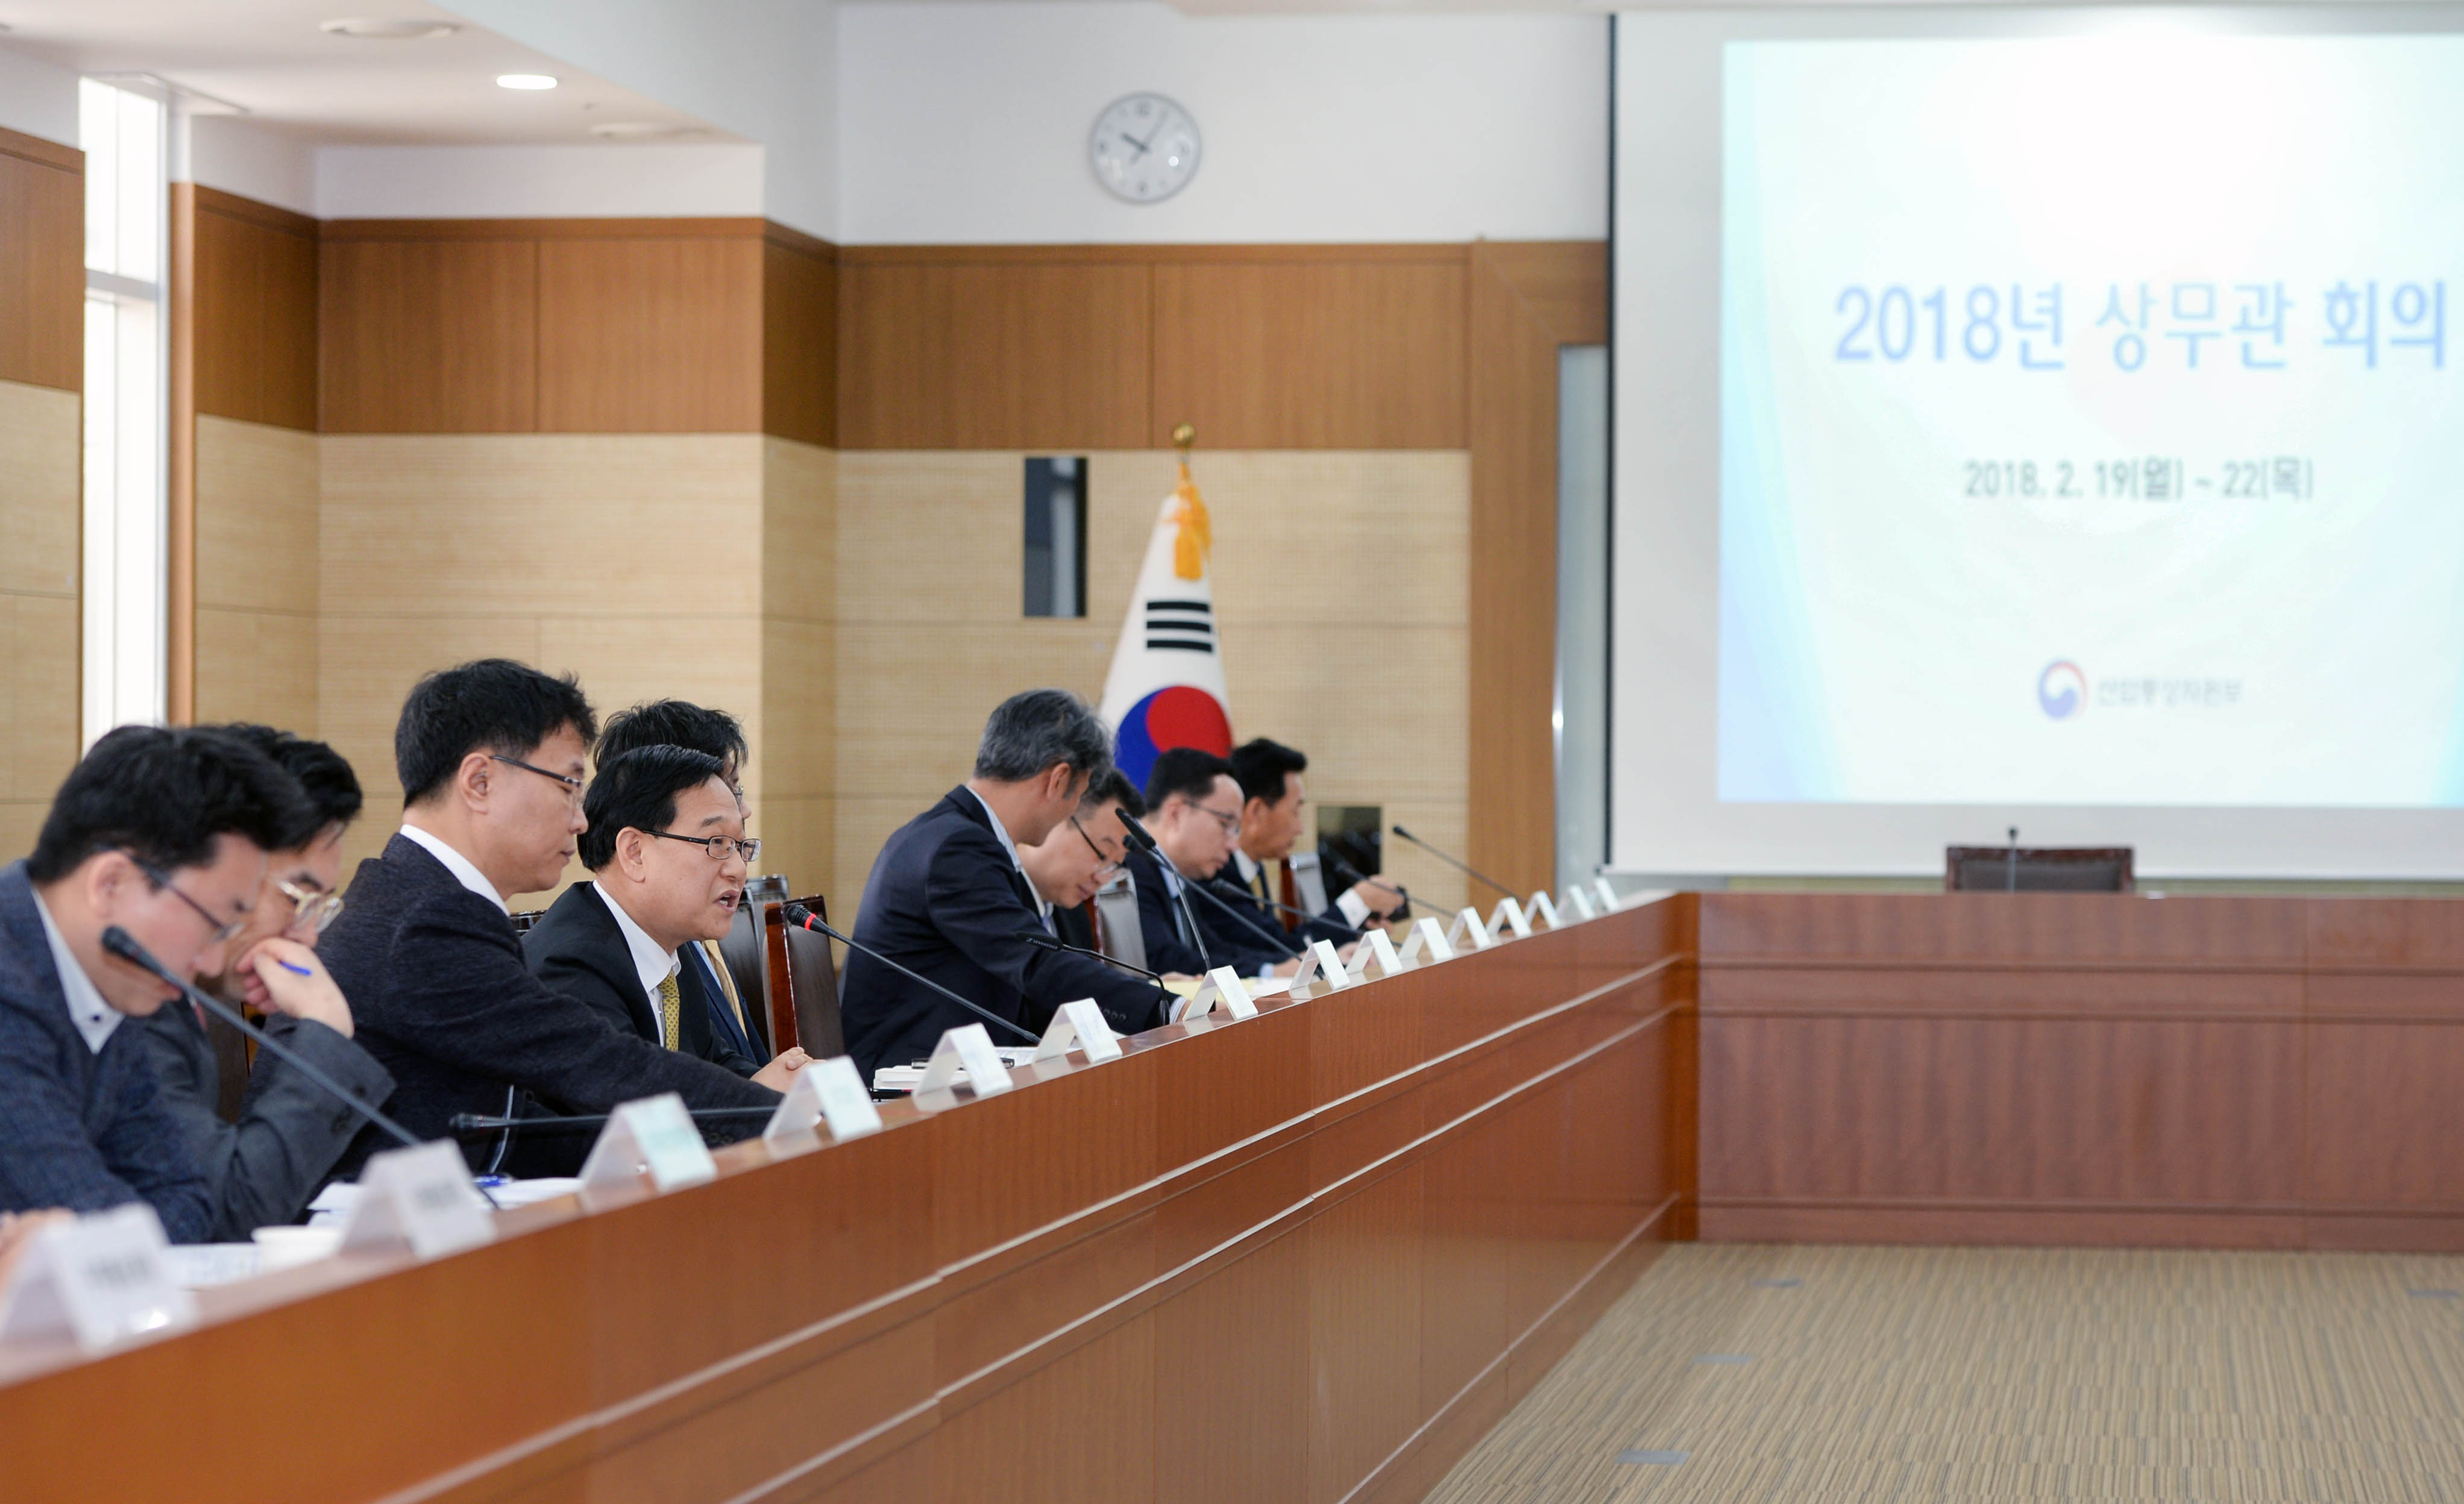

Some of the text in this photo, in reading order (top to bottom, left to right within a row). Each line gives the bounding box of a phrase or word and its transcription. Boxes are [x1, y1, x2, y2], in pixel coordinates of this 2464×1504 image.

[1834, 278, 2448, 372] 2018년 상무관 회의
[1962, 460, 2047, 499] 2018.
[2054, 460, 2084, 499] 2.
[2094, 455, 2184, 501] 19(월)
[2220, 456, 2313, 501] 22(목)
